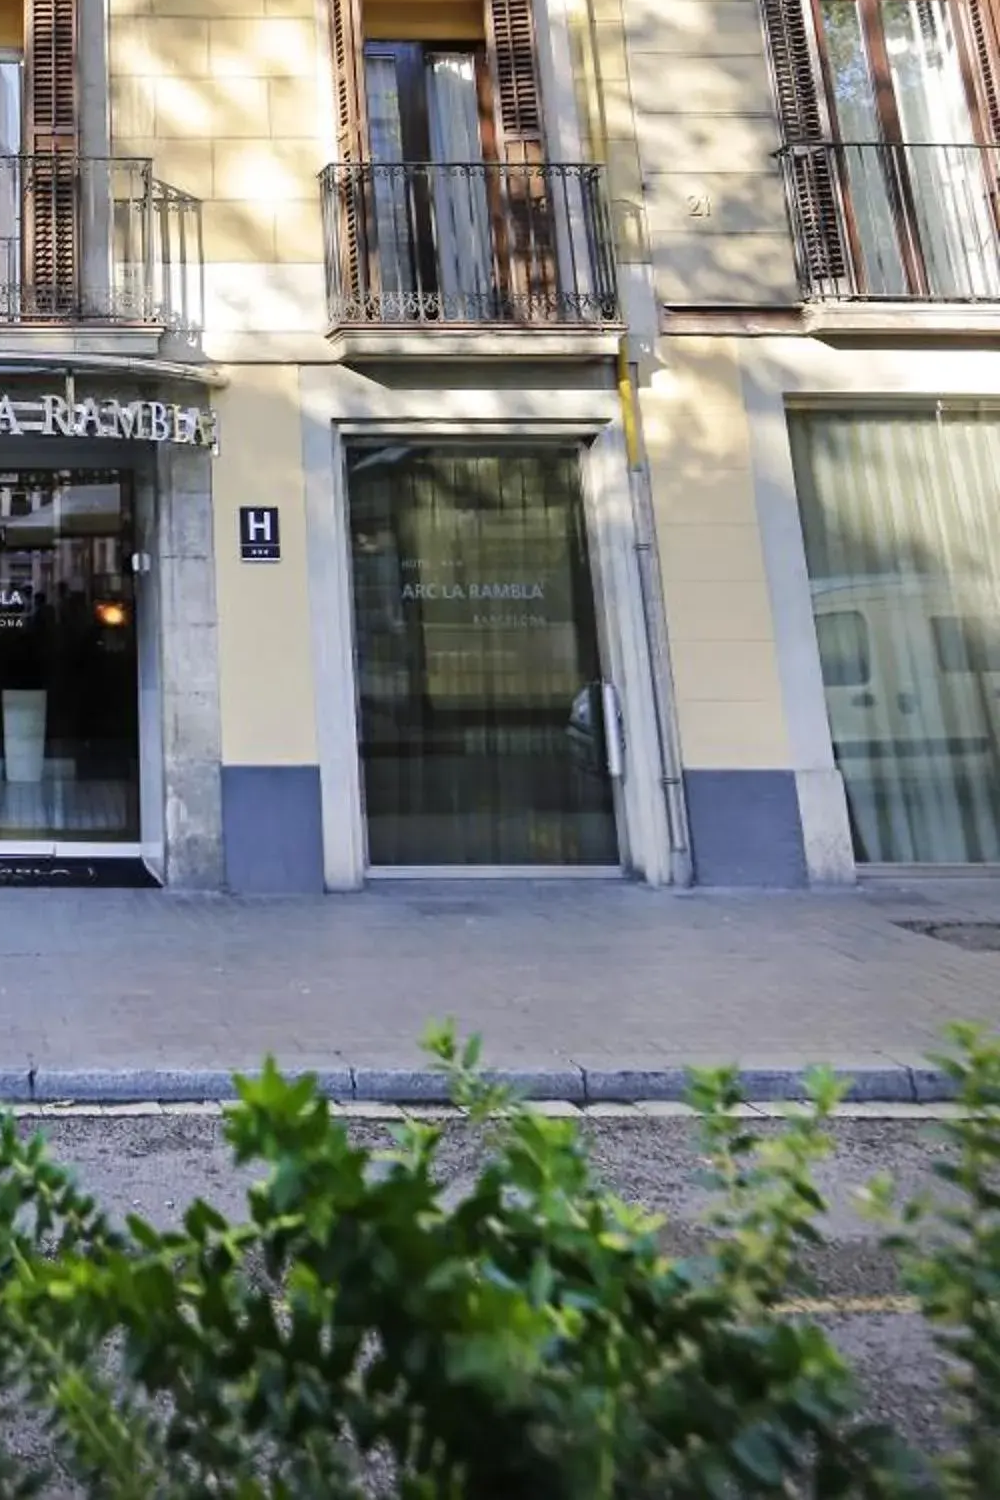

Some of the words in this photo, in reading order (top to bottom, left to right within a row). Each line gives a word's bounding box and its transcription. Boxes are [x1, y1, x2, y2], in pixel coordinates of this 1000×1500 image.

[686, 194, 711, 217] 21
[41, 395, 218, 452] RAMBLA
[248, 511, 271, 541] H
[401, 583, 438, 599] ARC
[441, 583, 465, 599] LA
[468, 583, 544, 599] RAMBLA
